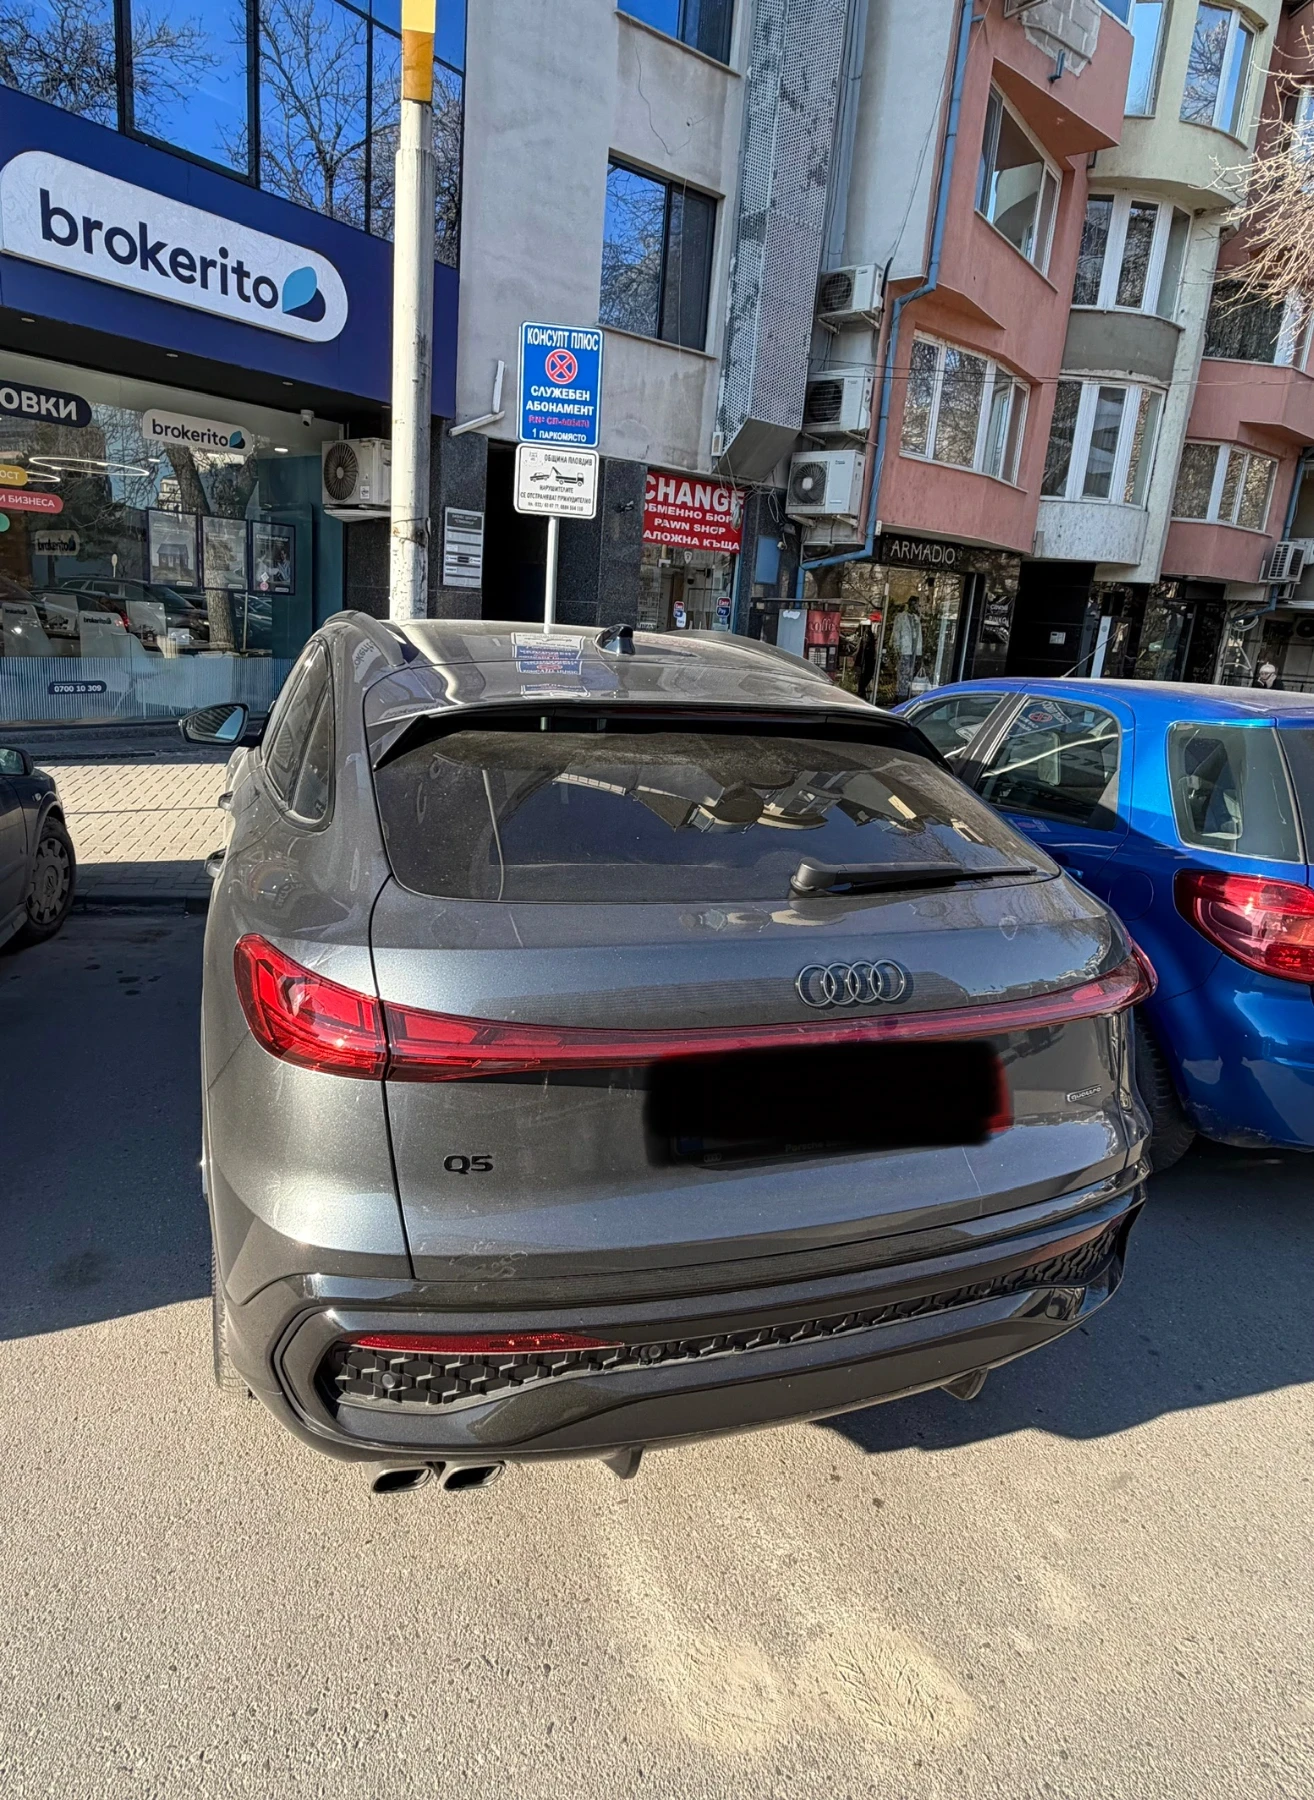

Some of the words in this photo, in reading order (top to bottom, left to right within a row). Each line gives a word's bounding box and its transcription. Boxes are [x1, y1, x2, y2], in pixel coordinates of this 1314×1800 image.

[40, 188, 279, 309] brokerito
[527, 327, 569, 348] КОНСУЛТ
[571, 332, 599, 351] ПЛЮС
[531, 385, 590, 401] СЛУЖЕБЕН
[526, 400, 594, 416] АБОНАМЕНТ
[152, 418, 228, 446] brokerito
[532, 428, 537, 438] 1
[539, 430, 587, 442] ПАРКОМЯСТО
[544, 454, 567, 463] ОБЩИНА
[568, 456, 592, 466] ПЛОВДИВ
[8, 496, 55, 507] БИЗНЕСА
[654, 518, 690, 530] PAWN
[693, 524, 726, 535] SHOP
[703, 538, 740, 550] КЪЩА
[890, 540, 956, 564] ARMADIO
[444, 1154, 493, 1174] Q5
